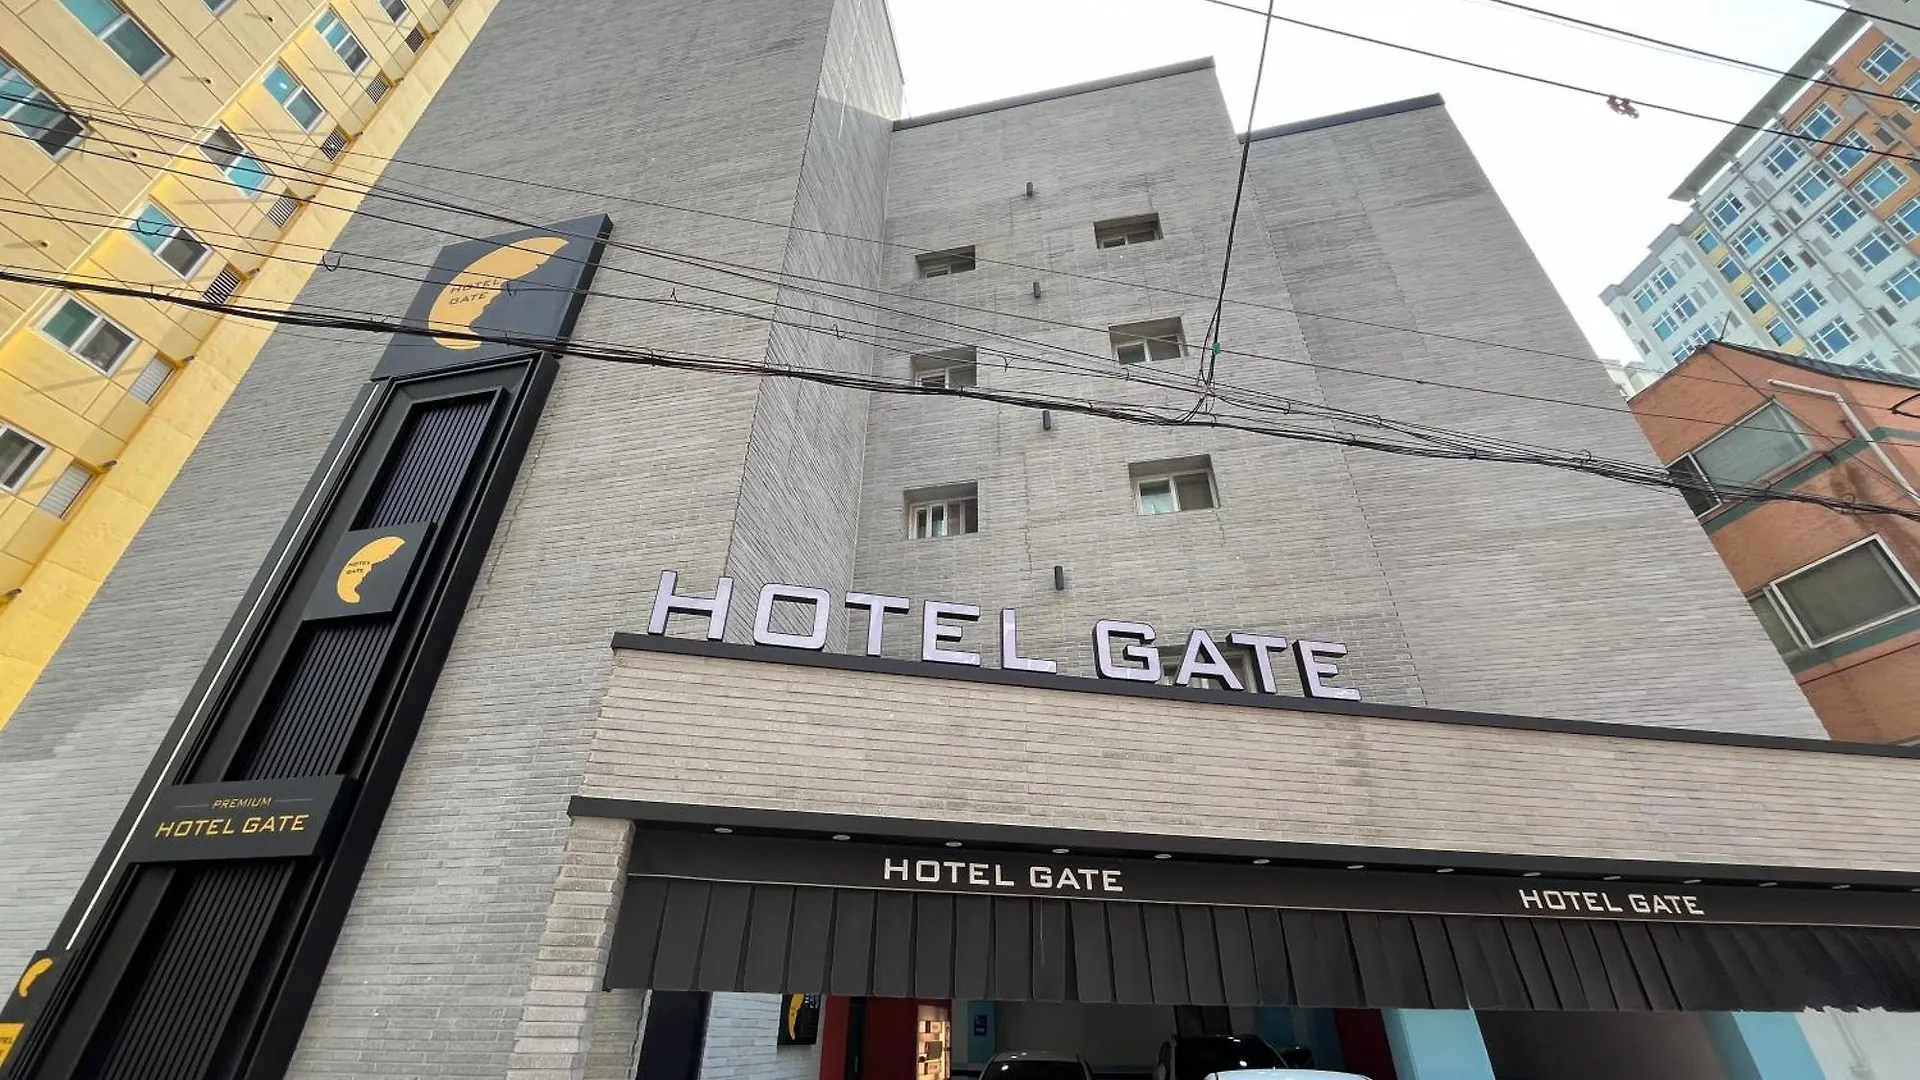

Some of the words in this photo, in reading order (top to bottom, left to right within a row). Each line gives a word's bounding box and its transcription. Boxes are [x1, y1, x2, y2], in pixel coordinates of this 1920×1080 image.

[449, 291, 489, 305] GATE
[648, 569, 1056, 674] HOTEL
[1093, 618, 1361, 701] GATE
[212, 797, 272, 809] PREMIUM
[155, 819, 235, 838] HOTEL
[242, 814, 309, 833] GATE
[884, 857, 1015, 887] HOTEL
[1029, 866, 1124, 892] GATE
[1519, 889, 1623, 912] HOTEL
[1628, 893, 1705, 915] GATE
